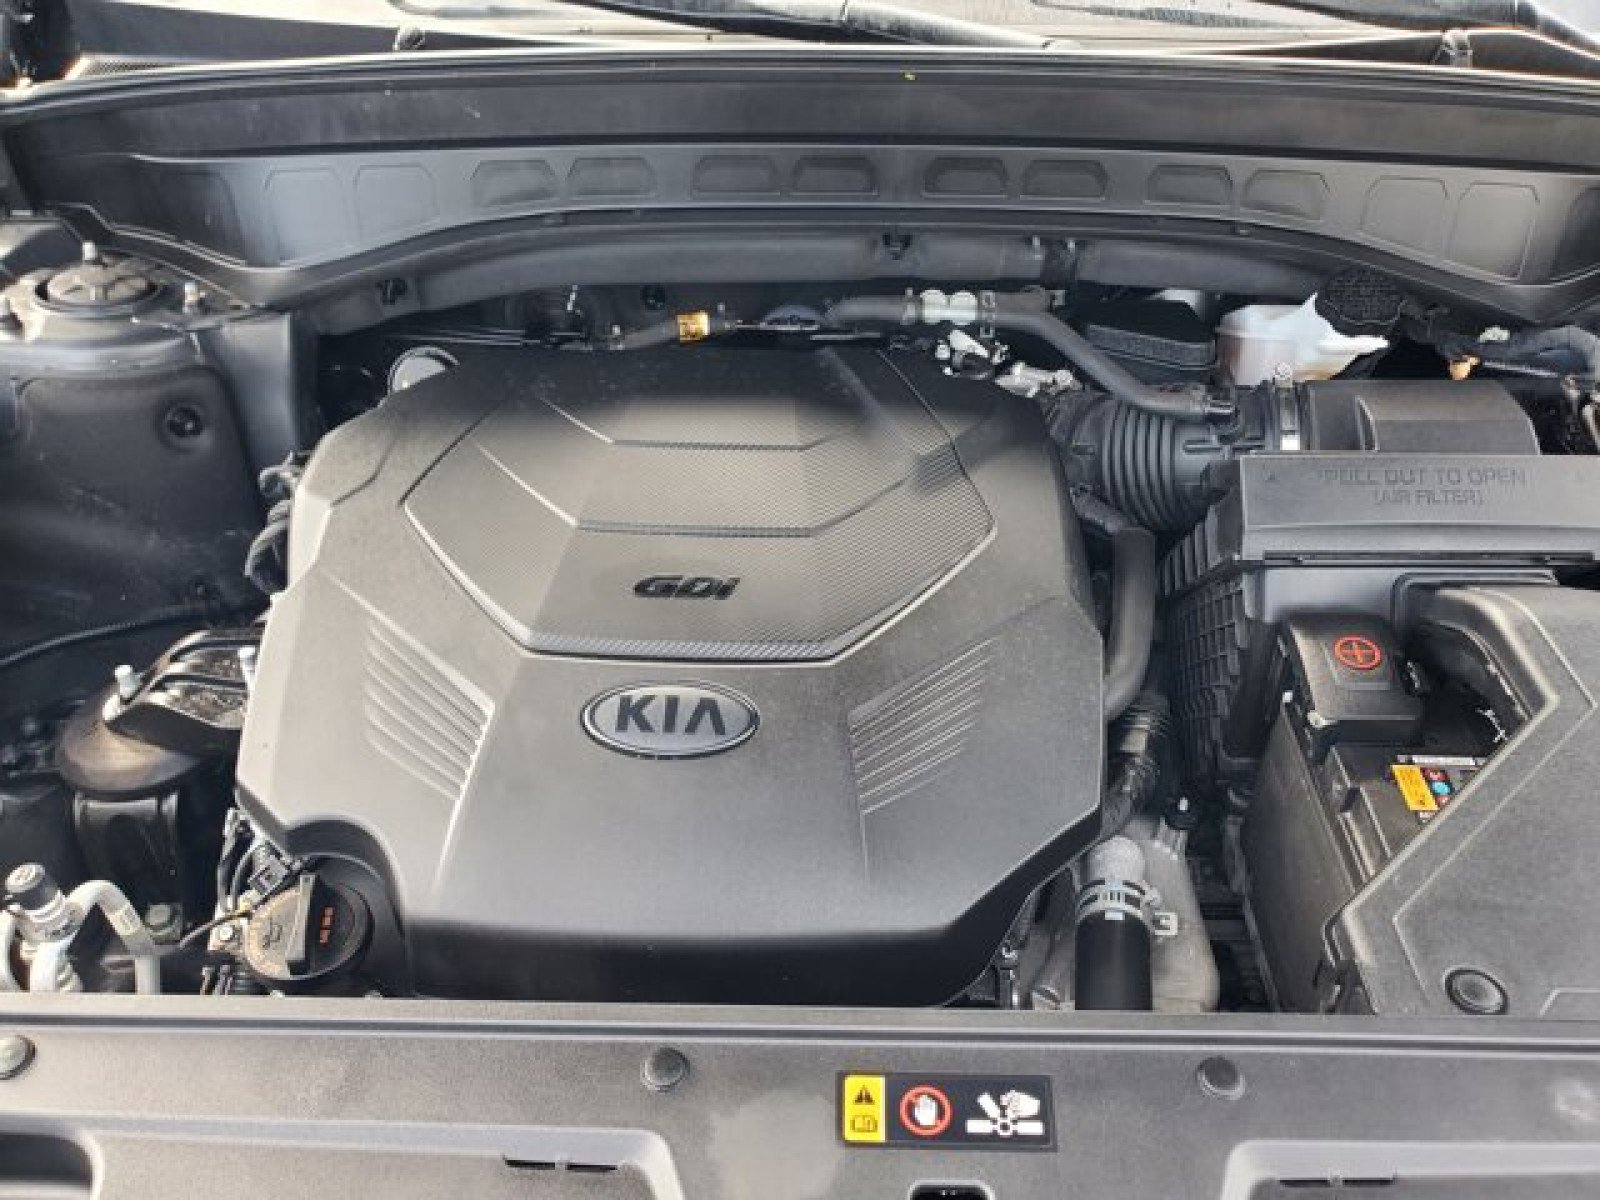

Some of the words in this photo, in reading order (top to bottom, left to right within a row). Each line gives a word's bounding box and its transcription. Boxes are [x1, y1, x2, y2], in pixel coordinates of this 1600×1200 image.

[1384, 467, 1427, 486] OUT
[1436, 467, 1462, 486] TO
[1467, 467, 1526, 487] OPEN
[615, 695, 726, 735] KIA
